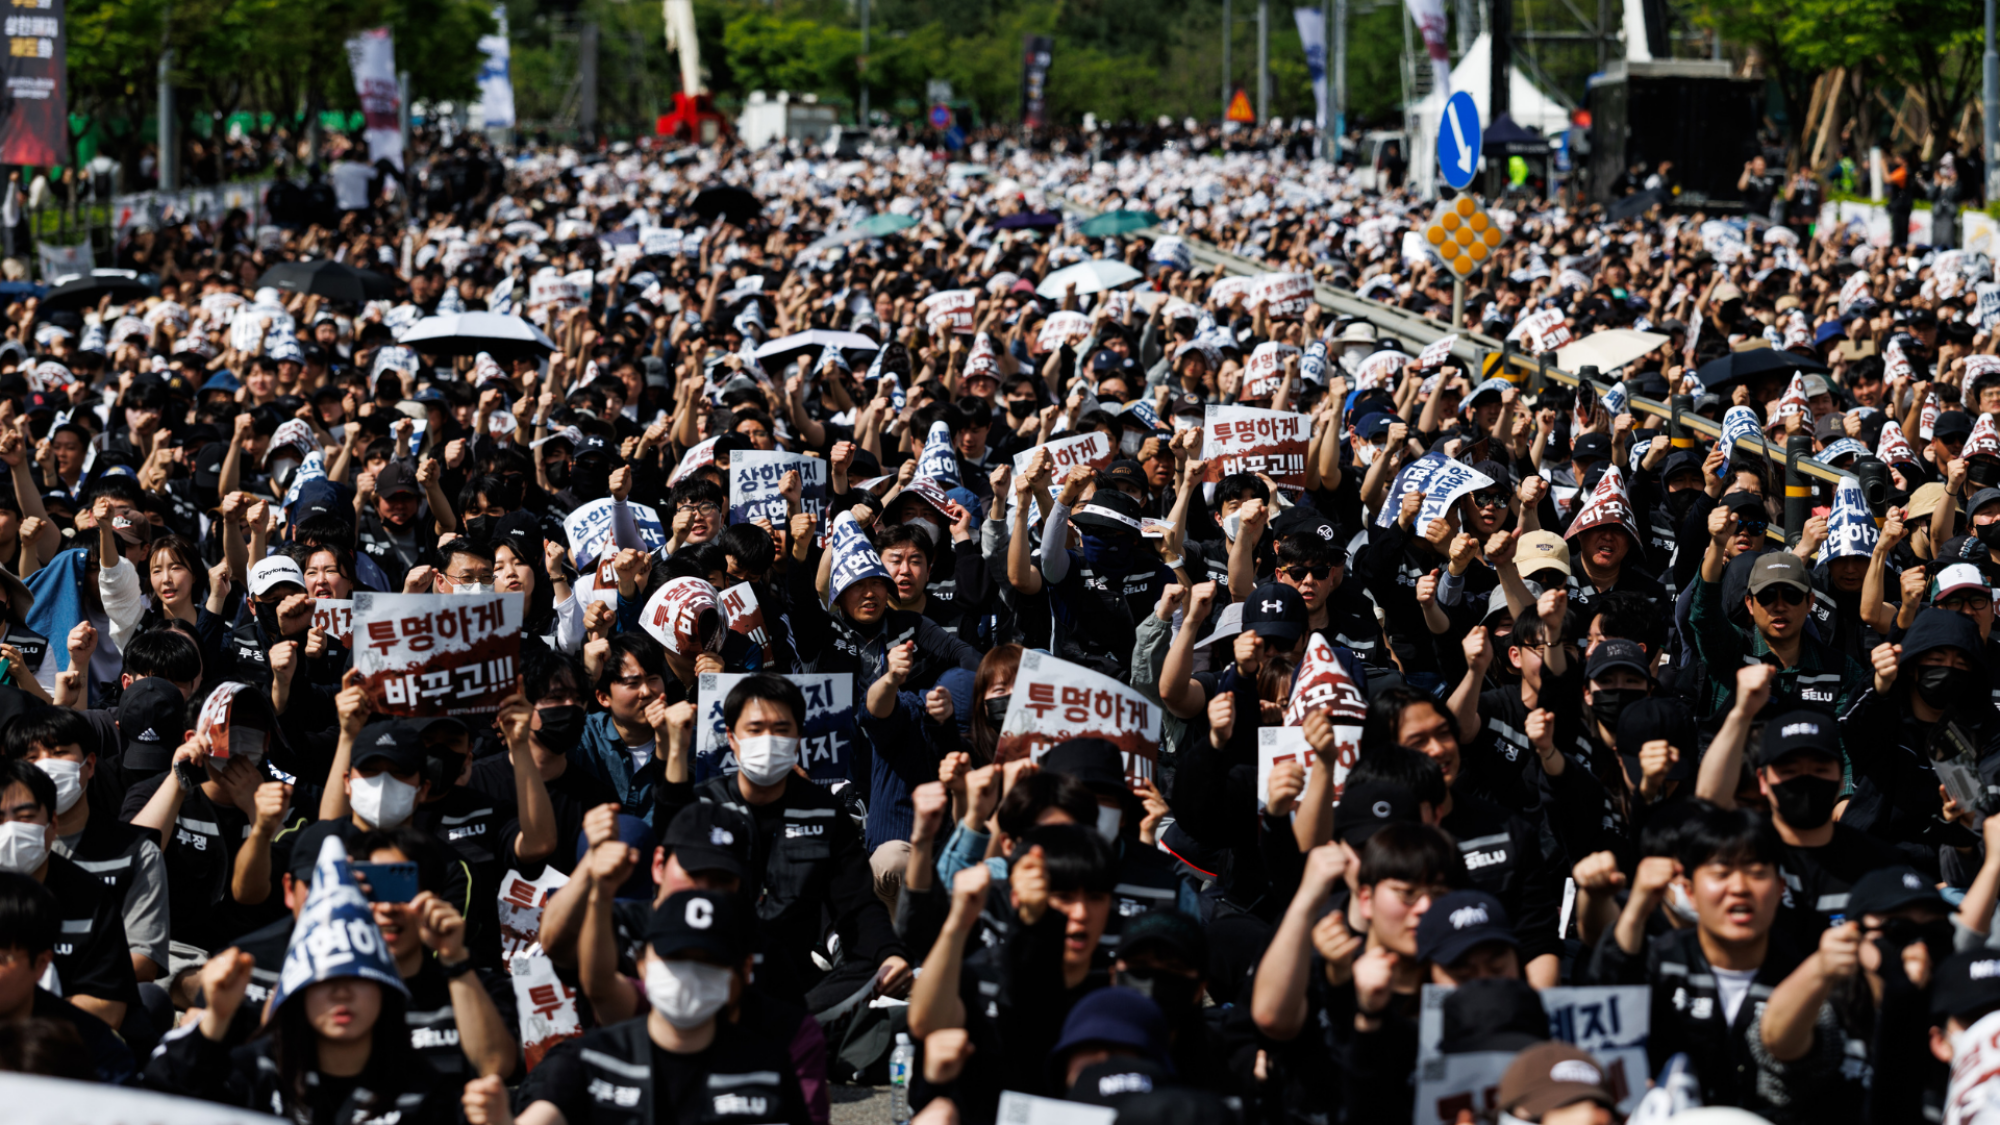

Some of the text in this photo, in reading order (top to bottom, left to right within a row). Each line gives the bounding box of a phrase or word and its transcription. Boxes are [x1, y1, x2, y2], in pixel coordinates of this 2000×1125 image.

[1213, 416, 1299, 447] 투명하게
[1223, 453, 1305, 477] 바꾸고!!!
[258, 567, 299, 580] TaylorMade
[367, 598, 505, 656] 투명하게
[383, 656, 515, 710] 바꾸고!!!
[1024, 682, 1149, 731] 투명하게
[1802, 691, 1833, 702] SELU
[177, 828, 207, 851] 투쟁
[785, 824, 824, 838] SELU
[1464, 849, 1507, 870] SELU
[685, 898, 714, 929] C
